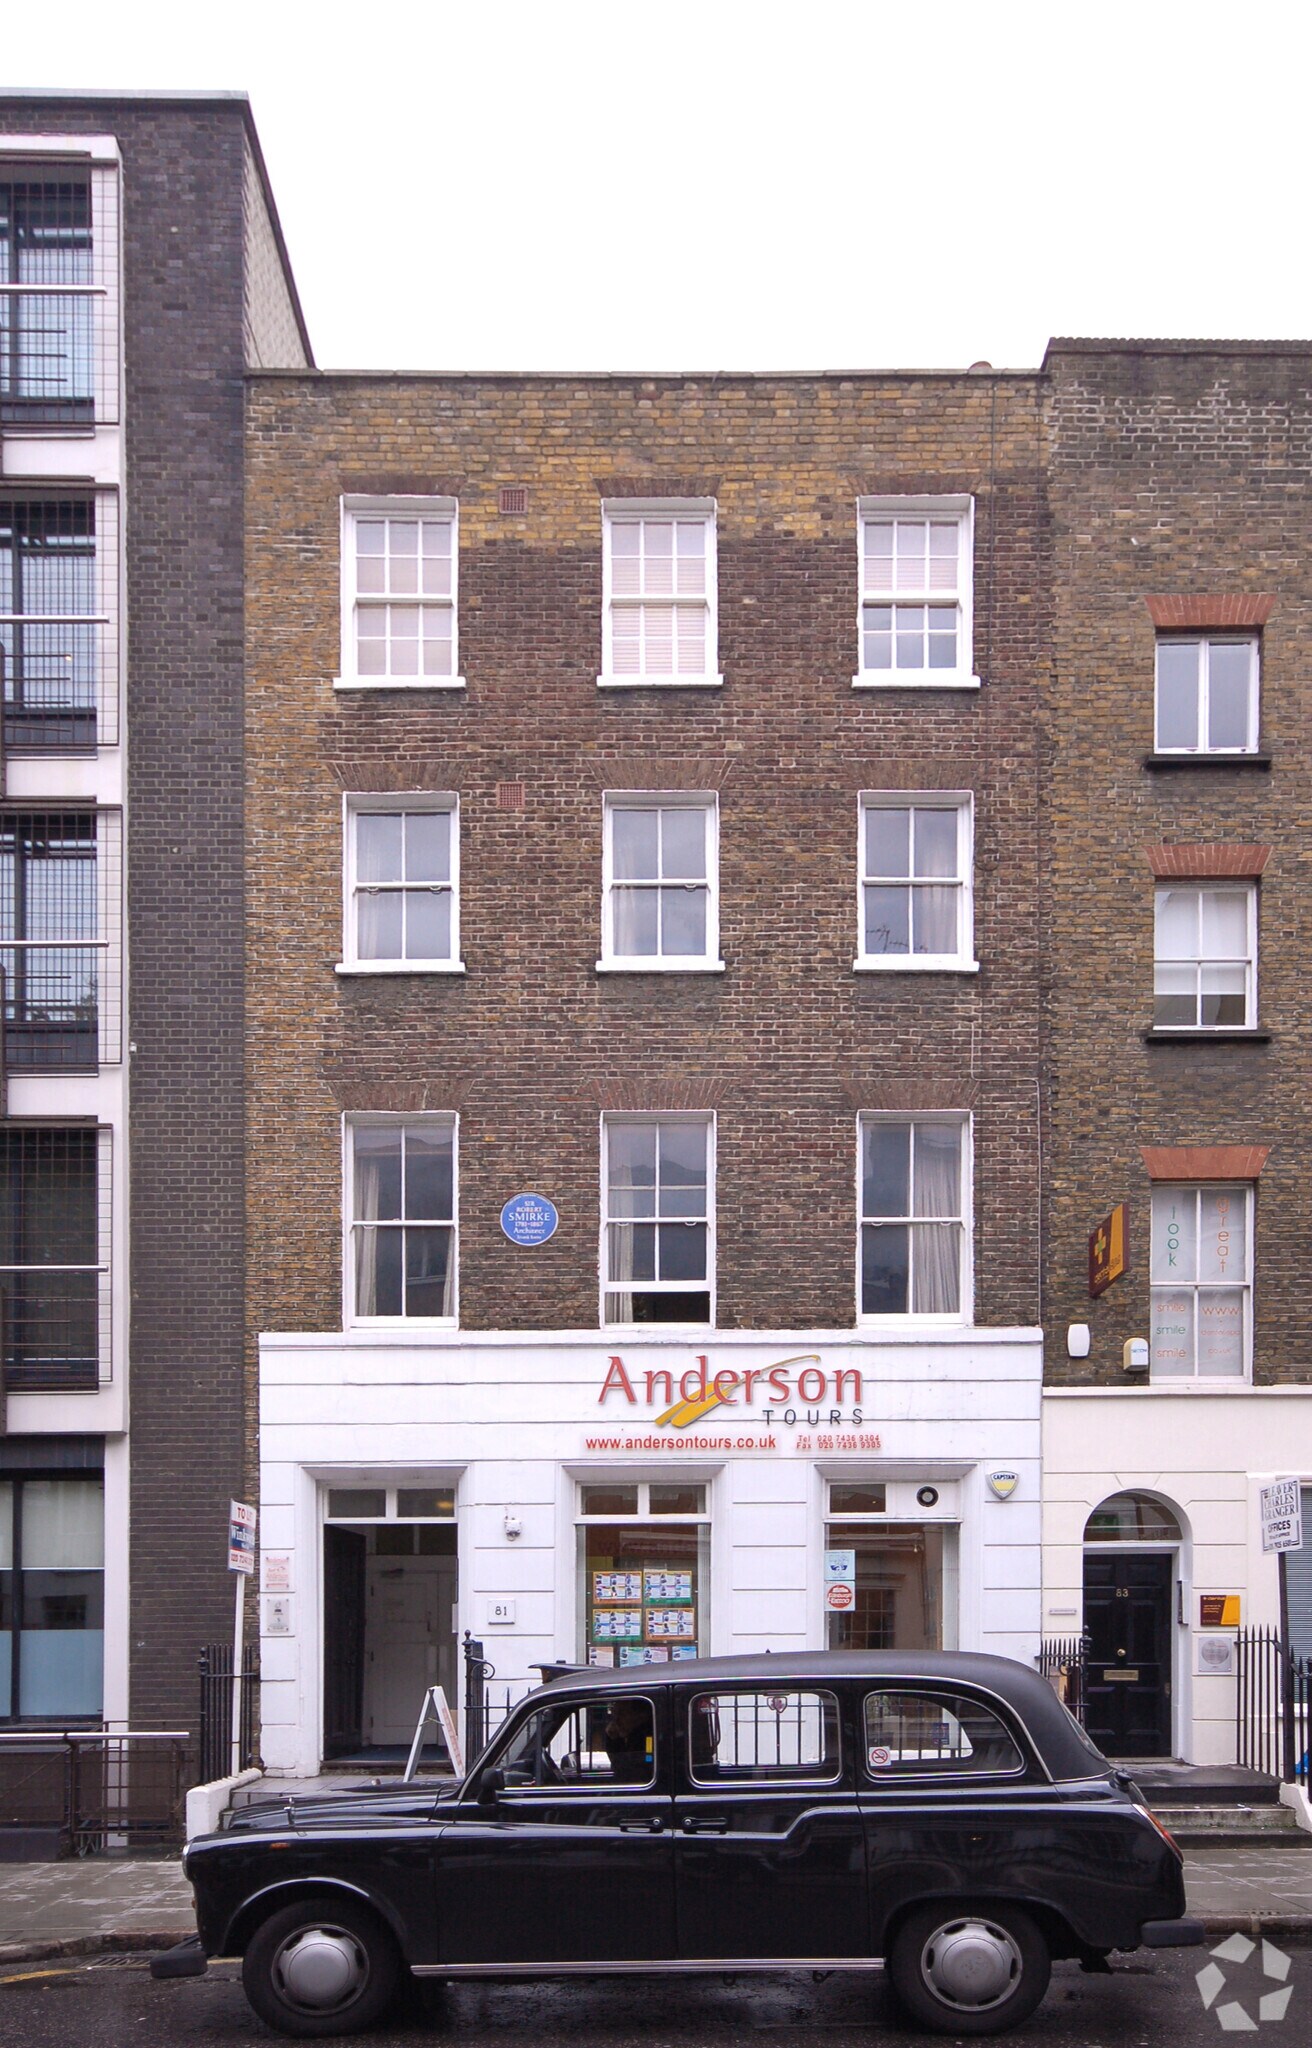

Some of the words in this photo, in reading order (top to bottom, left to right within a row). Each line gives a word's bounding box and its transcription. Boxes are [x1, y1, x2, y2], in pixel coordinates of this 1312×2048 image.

[508, 1213, 551, 1221] SMIRKE
[1167, 1206, 1179, 1266] look
[1216, 1197, 1230, 1273] great
[1157, 1303, 1186, 1313] smile
[1157, 1325, 1186, 1335] smile
[1157, 1347, 1186, 1357] smile
[597, 1355, 864, 1404] Anderson
[762, 1408, 863, 1426] TOURS
[585, 1434, 776, 1450] www.andersontours.co.uk
[1264, 1493, 1294, 1510] CHARLES
[237, 1506, 246, 1519] TO
[1264, 1504, 1295, 1520] GRANGER
[1268, 1520, 1291, 1533] OFFICES
[1116, 1588, 1129, 1597] 83
[495, 1606, 507, 1616] 81
